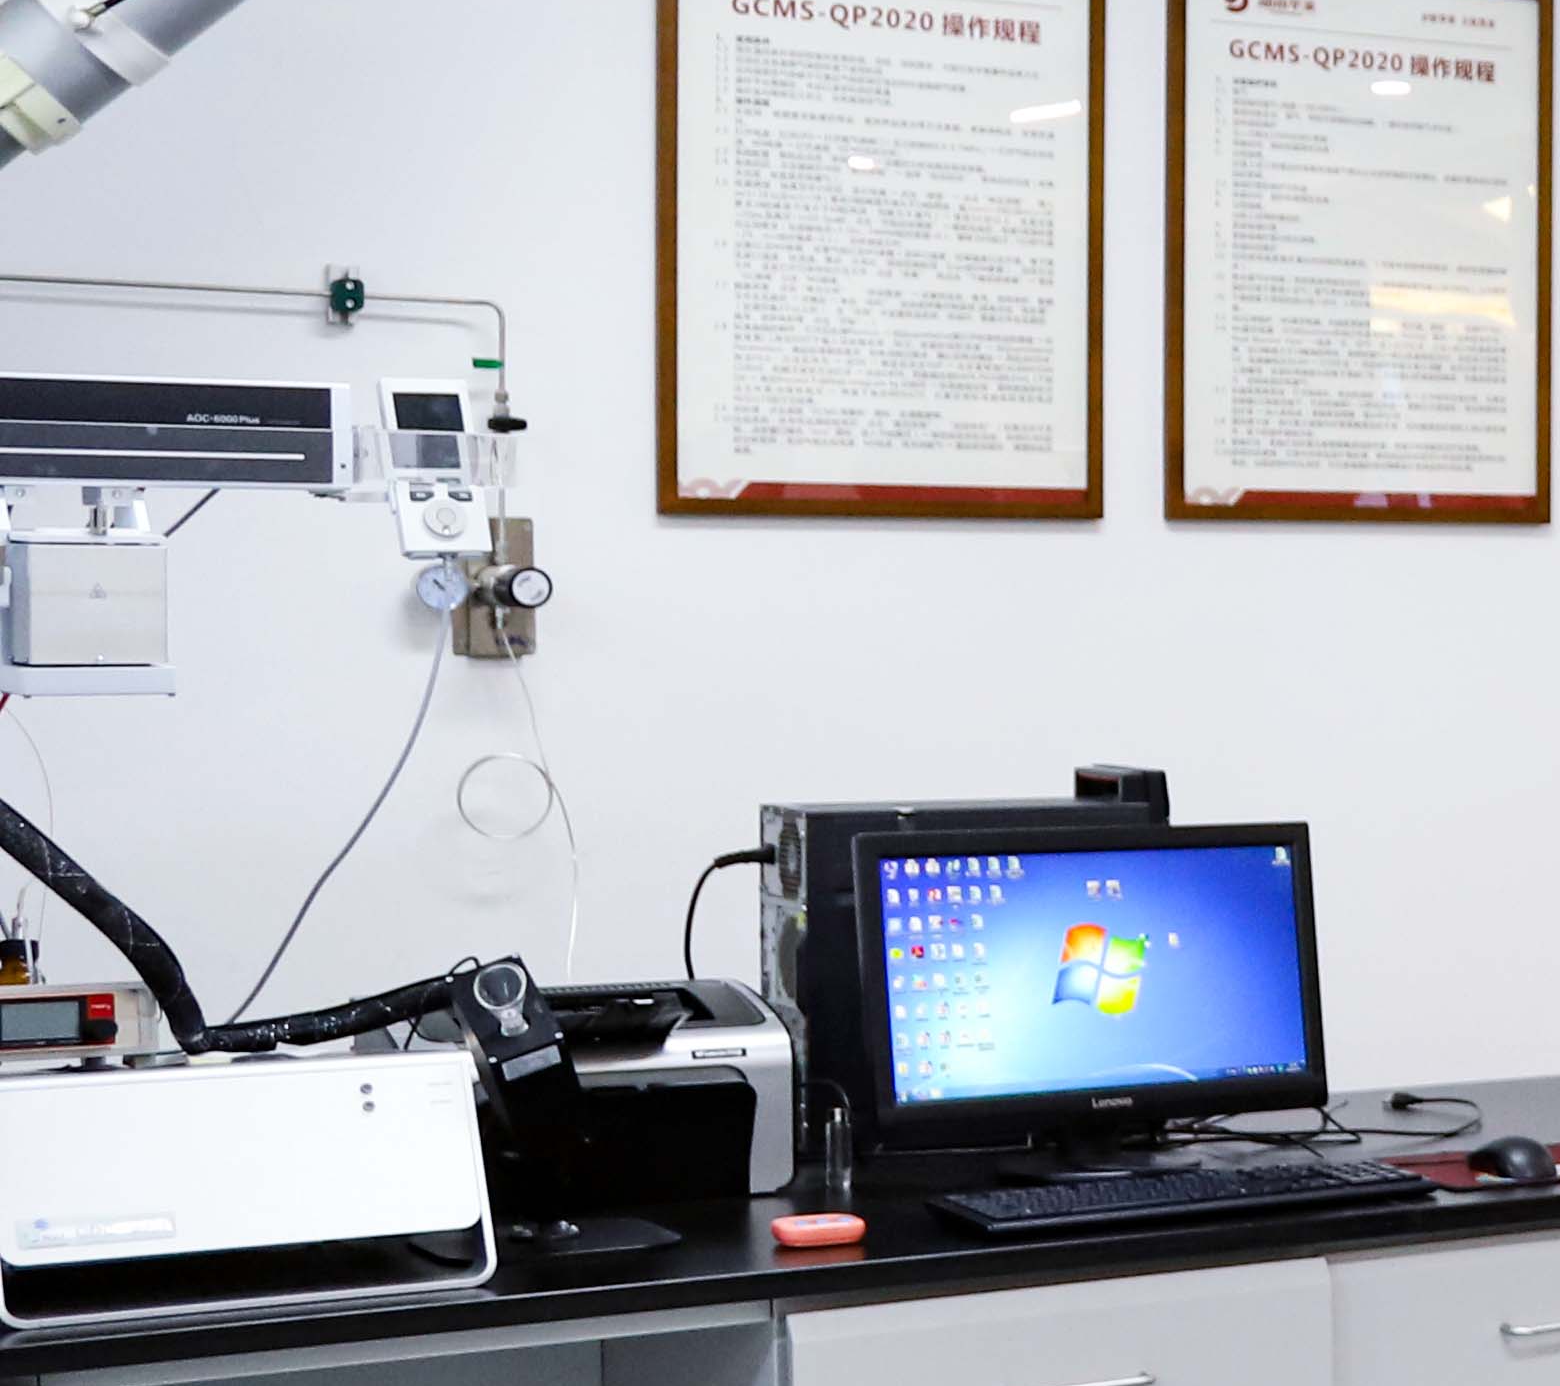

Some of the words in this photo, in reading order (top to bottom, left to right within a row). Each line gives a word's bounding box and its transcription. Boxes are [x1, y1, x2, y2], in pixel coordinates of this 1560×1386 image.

[943, 13, 1041, 44] 操作规程
[1229, 39, 1403, 71] GCMS-QP2020
[1410, 54, 1495, 82] 操作规程
